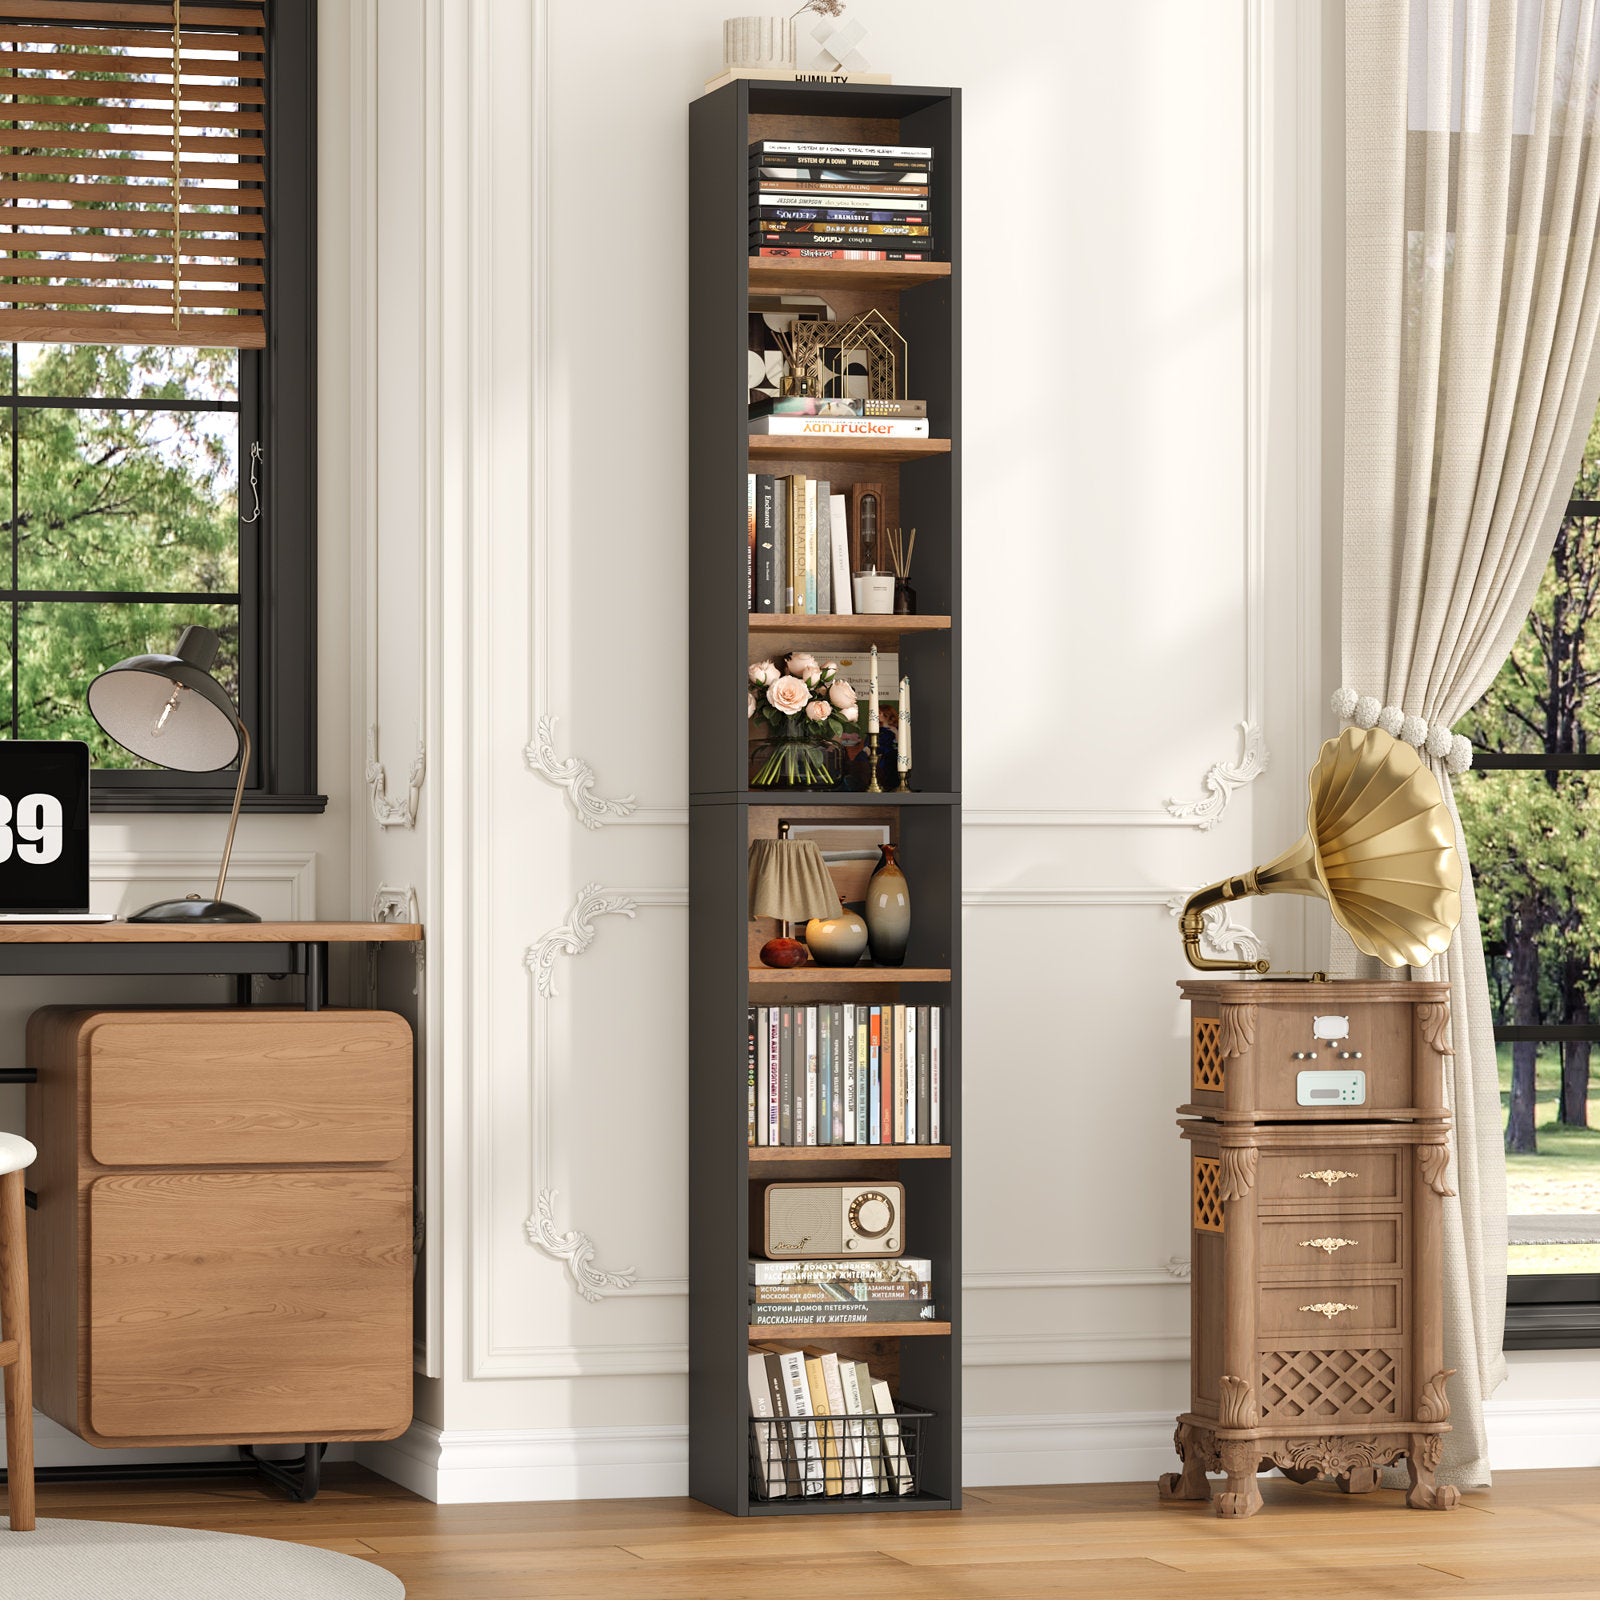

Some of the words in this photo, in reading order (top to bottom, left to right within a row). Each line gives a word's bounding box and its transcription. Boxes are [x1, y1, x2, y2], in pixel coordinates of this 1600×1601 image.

[0, 793, 63, 864] 9
[758, 1316, 814, 1324] РАССКАЗАННЫЕ
[850, 1380, 859, 1408] UNCOMMON
